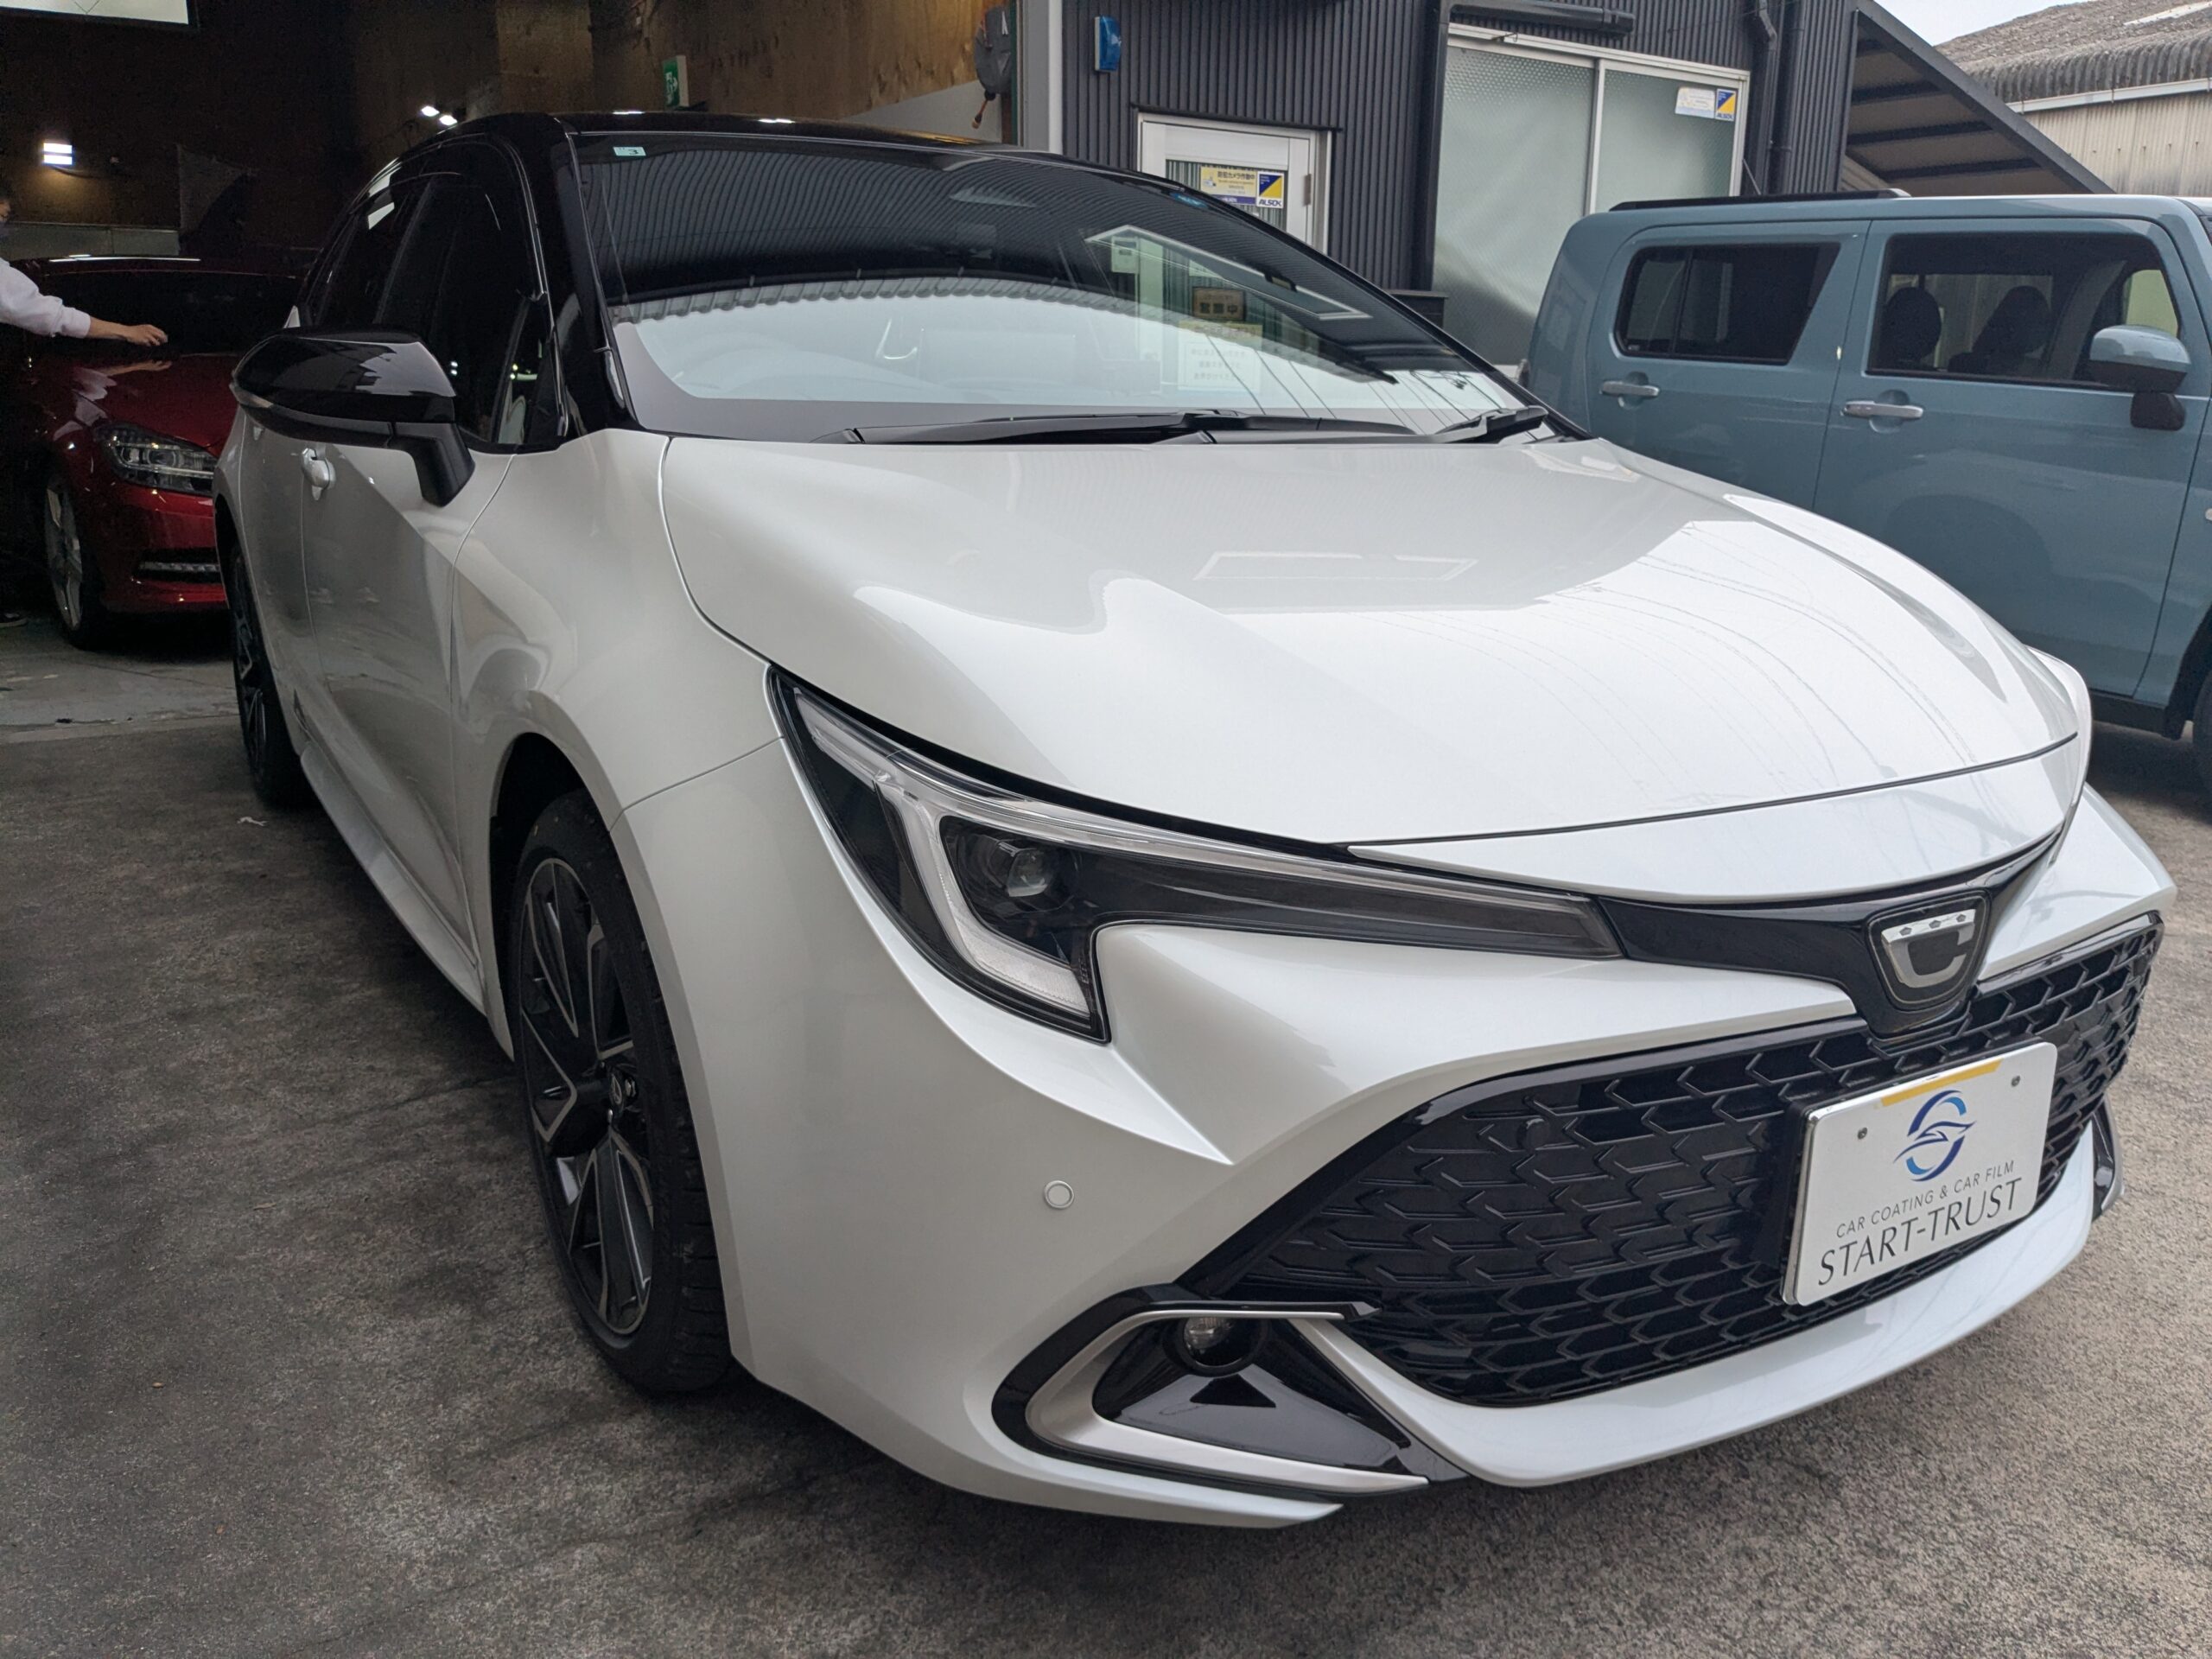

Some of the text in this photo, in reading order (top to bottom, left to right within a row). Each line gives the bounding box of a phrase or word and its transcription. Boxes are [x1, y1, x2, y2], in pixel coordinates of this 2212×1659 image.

[1818, 1177, 2022, 1287] START-TRUST
[1836, 1160, 2014, 1238] CAR COATING & CAR FILM
